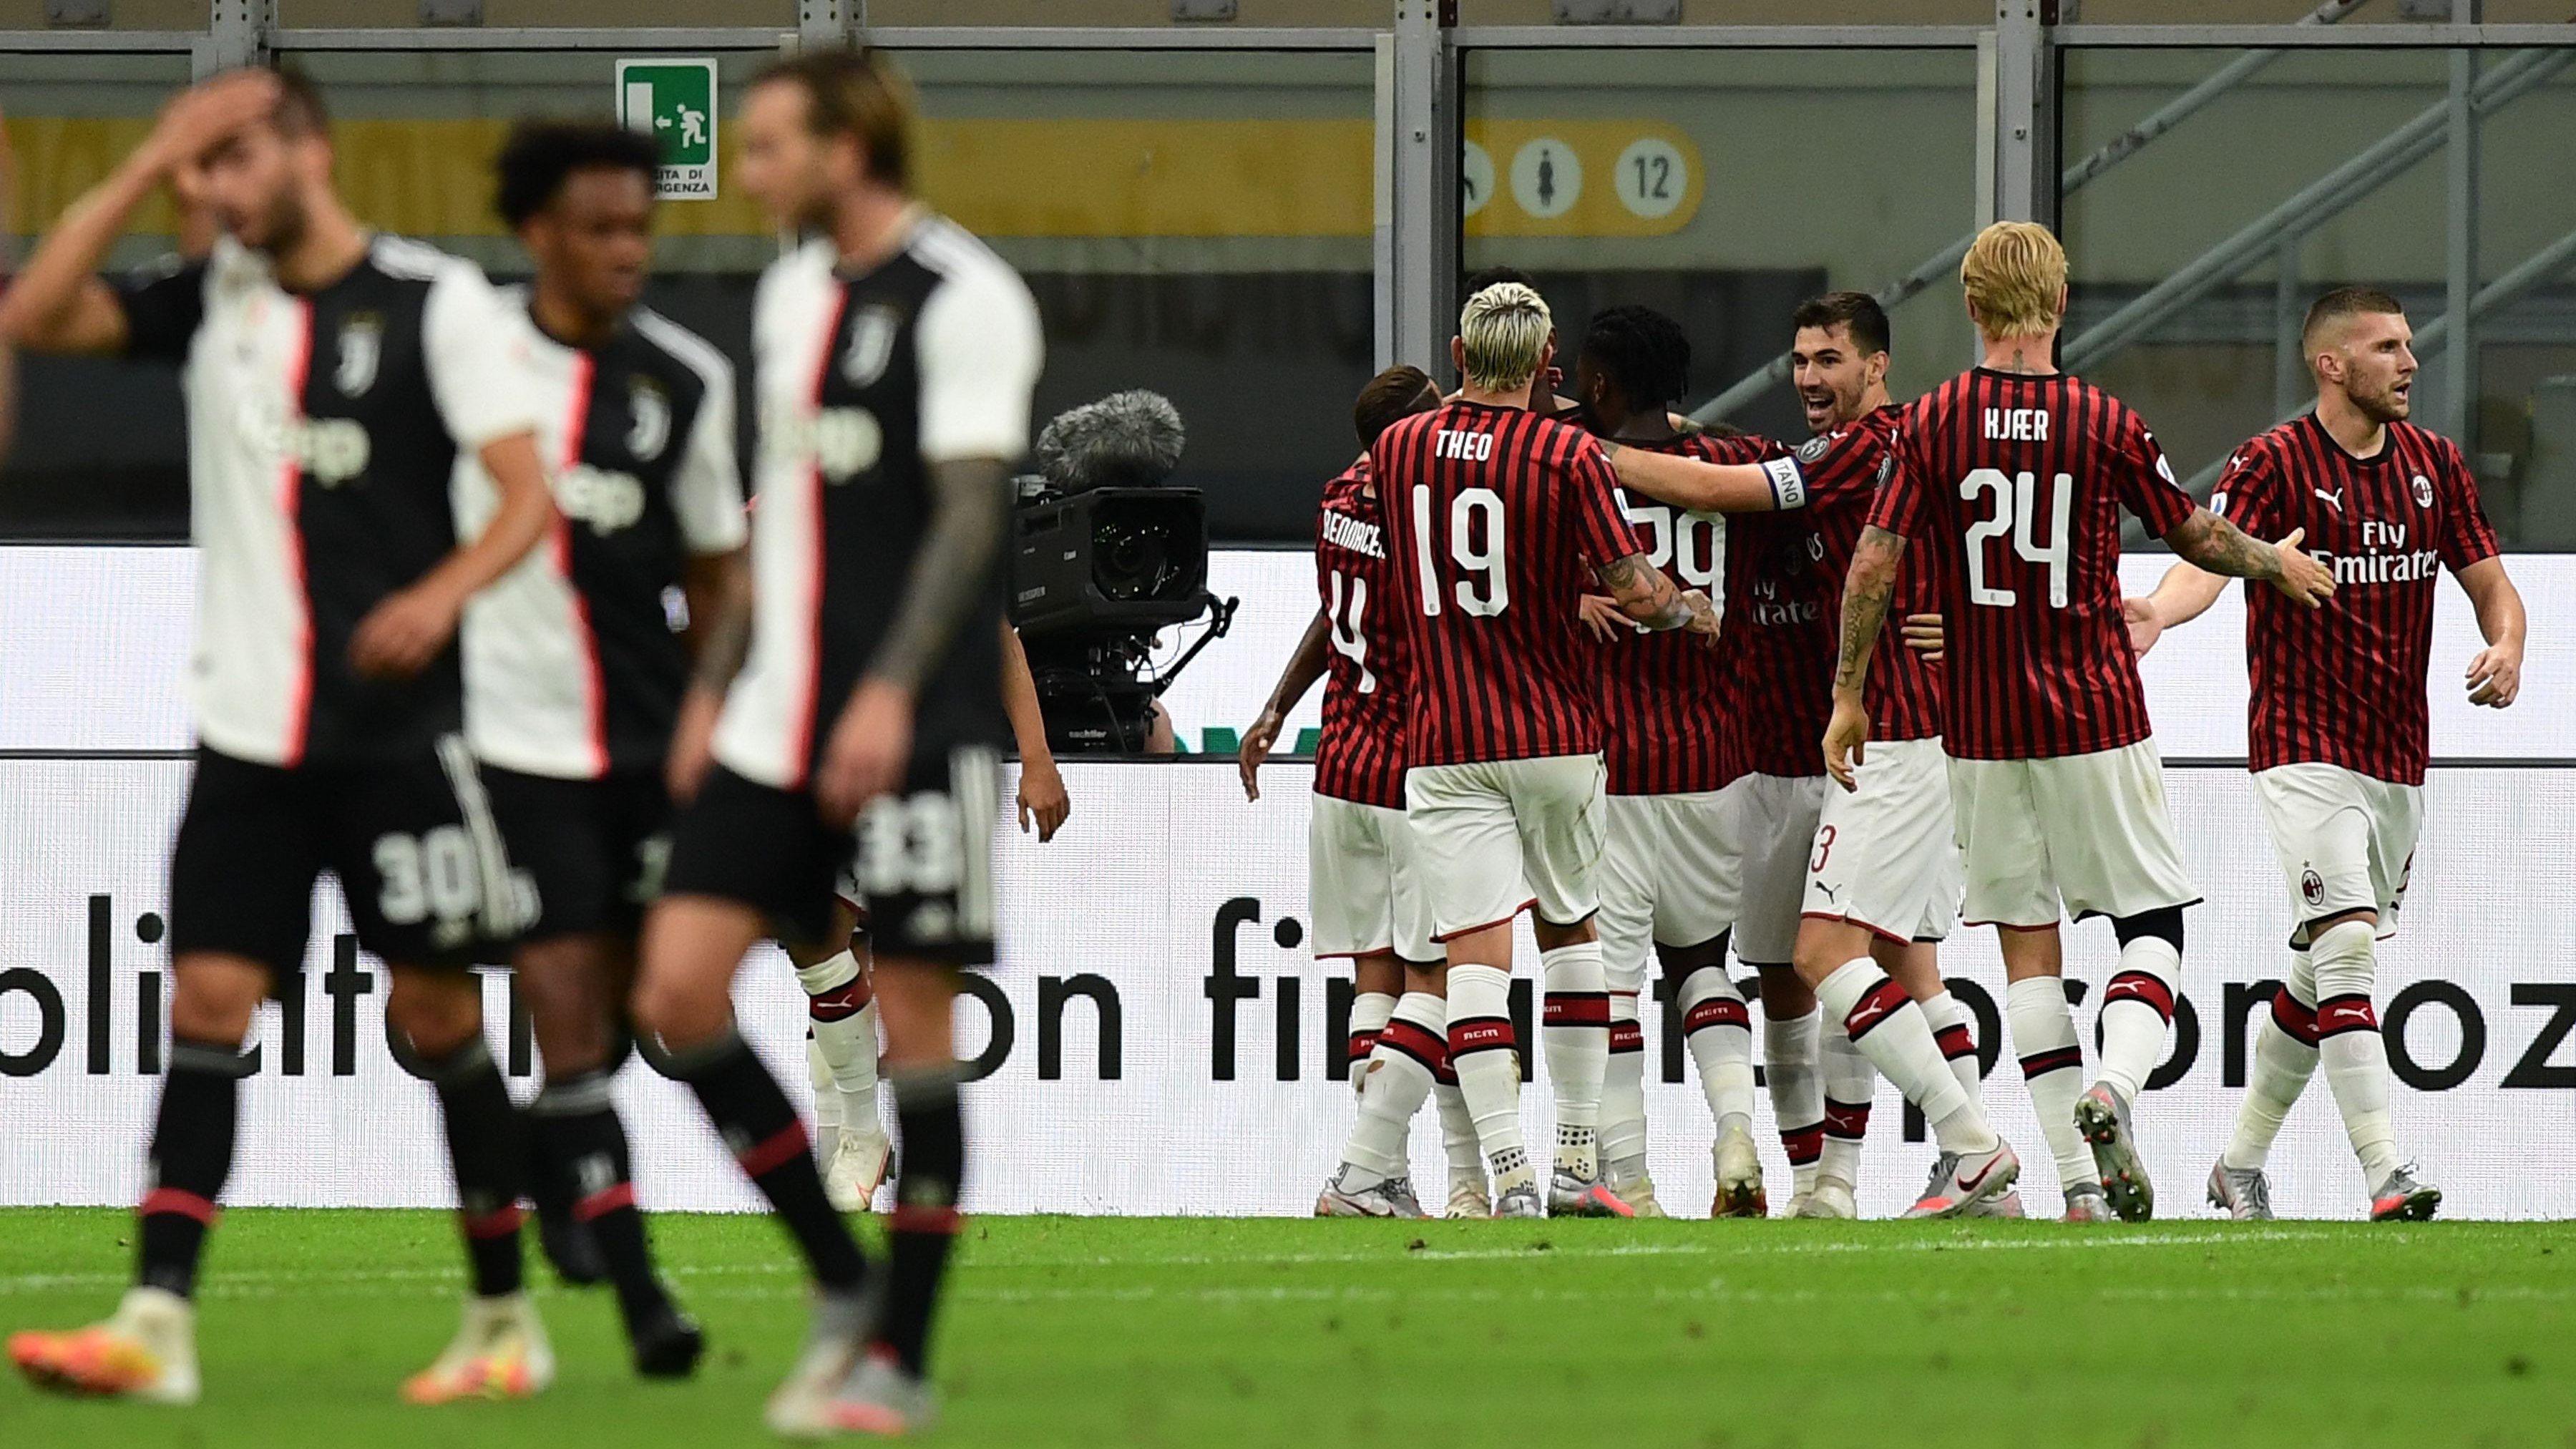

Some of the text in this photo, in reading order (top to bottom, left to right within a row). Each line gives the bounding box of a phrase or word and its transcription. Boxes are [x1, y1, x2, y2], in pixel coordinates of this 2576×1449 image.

[688, 170, 703, 179] DI
[1633, 155, 1669, 199] 12
[1435, 429, 1493, 462] THEO
[1984, 407, 2049, 441] KJÆR
[1322, 508, 1386, 560] BENNACE
[1413, 484, 1509, 617] 19
[1959, 468, 2072, 608] 24
[2362, 521, 2406, 550] Fly
[1329, 570, 1377, 694] 4
